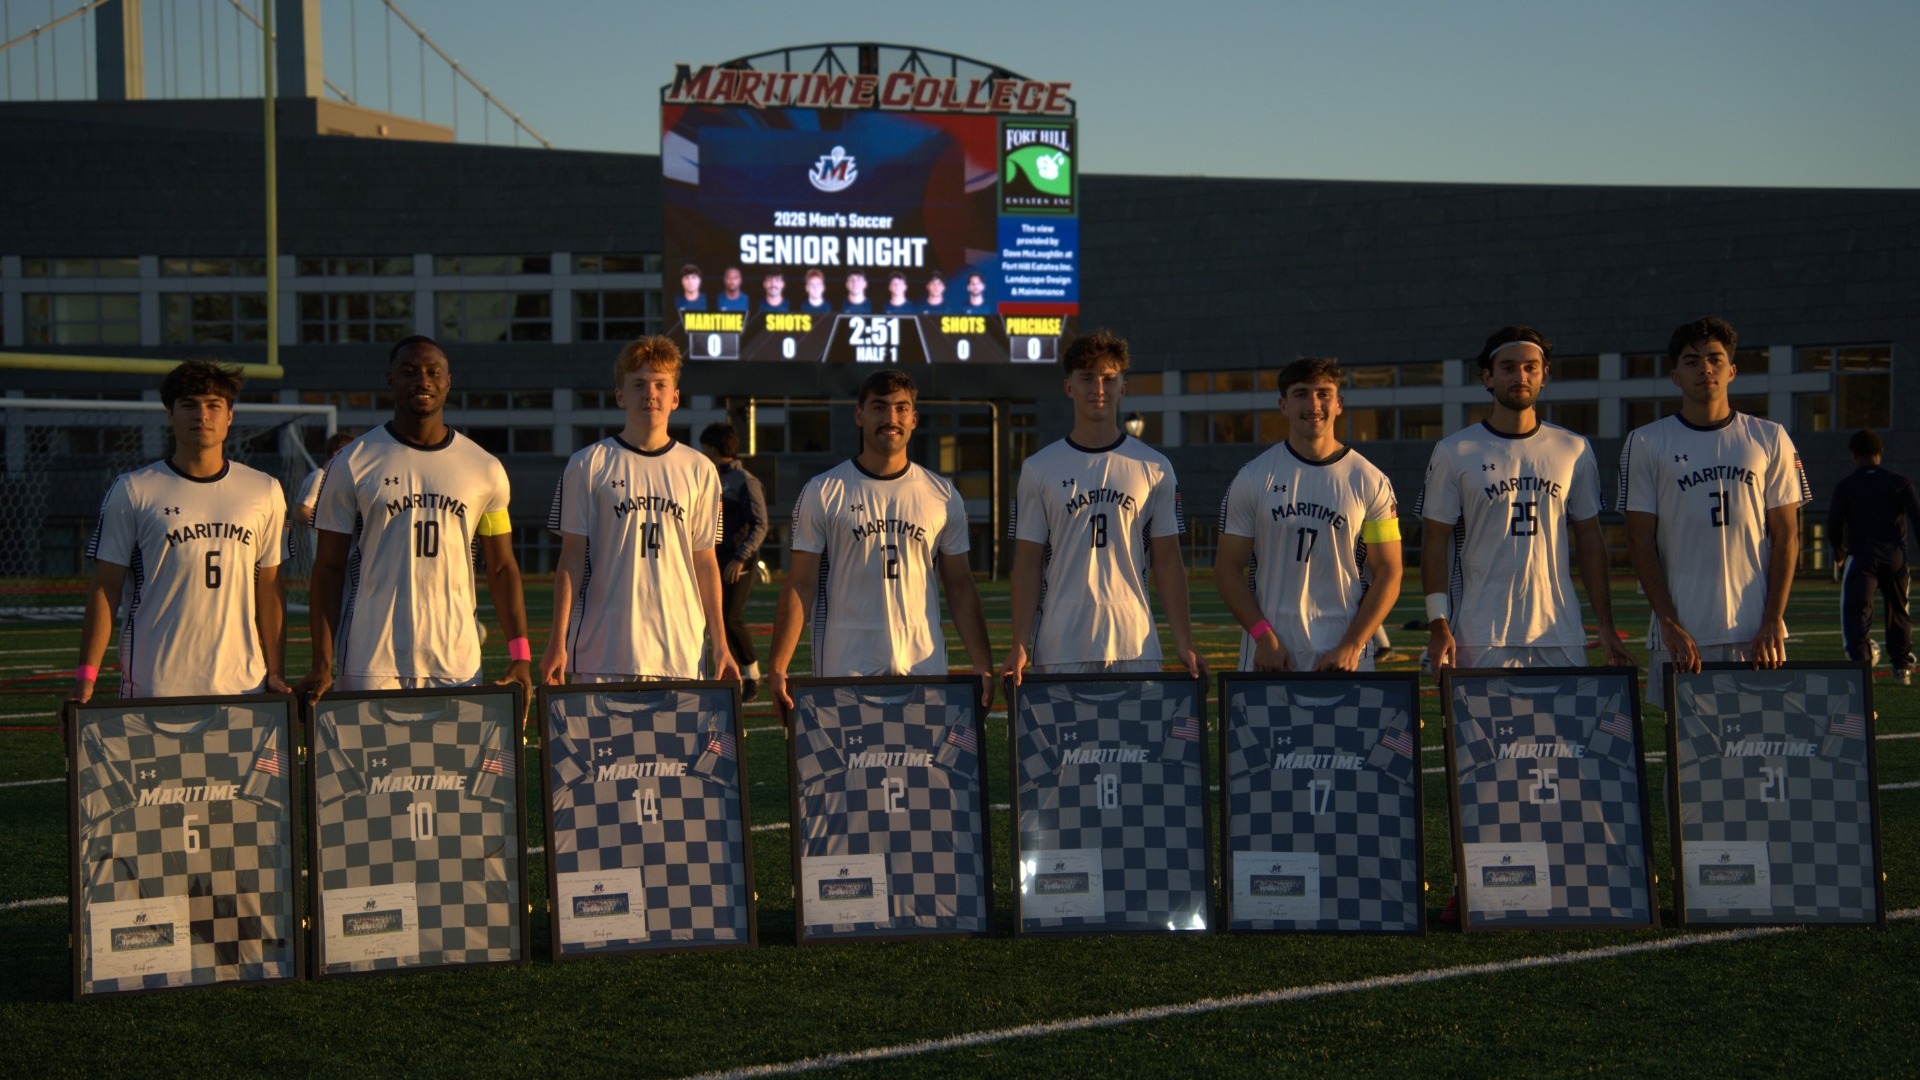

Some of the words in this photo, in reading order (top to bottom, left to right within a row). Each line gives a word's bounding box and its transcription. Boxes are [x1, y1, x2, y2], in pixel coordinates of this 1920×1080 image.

[668, 63, 876, 109] MARITIME
[884, 71, 1071, 114] COLLEGE
[1006, 129, 1037, 150] FORT
[1040, 130, 1070, 151] HILL
[774, 211, 807, 227] 2026
[809, 212, 846, 228] Men's
[848, 213, 893, 229] Soccer
[1021, 224, 1036, 233] The
[1036, 224, 1055, 233] view
[740, 234, 840, 266] SENIOR
[846, 236, 927, 267] NIGHT
[1003, 249, 1021, 258] Dave
[1064, 250, 1073, 259] at
[1016, 237, 1049, 247] provided
[1050, 237, 1060, 247] by
[1002, 262, 1017, 271] Fort
[1018, 262, 1030, 271] Hill
[1031, 262, 1059, 271] Estates
[1004, 275, 1045, 285] Landscape
[1045, 275, 1072, 286] Design
[1018, 287, 1065, 296] Maintenance
[684, 313, 743, 332] MARITIME
[766, 314, 812, 332] SHOTS
[849, 316, 900, 346] 2:51
[941, 316, 986, 334] SHOTS
[1006, 317, 1062, 335] PURCHASE
[707, 333, 722, 357] 0
[782, 337, 796, 359] 0
[856, 346, 886, 362] HALF
[889, 347, 898, 362] 1
[957, 339, 970, 360] 0
[1027, 338, 1041, 360] 0
[1484, 477, 1562, 501] MARITIME
[1677, 465, 1757, 492] MARITIME
[385, 493, 468, 519] MARITIME
[613, 496, 685, 522] MARITIME
[1065, 488, 1135, 514] MARITIME
[1708, 490, 1729, 528] 21
[1271, 502, 1346, 531] MARITIME
[1511, 501, 1538, 537] 25
[165, 522, 254, 548] MARITIME
[414, 520, 439, 558] 10
[639, 522, 661, 559] 14
[851, 519, 927, 544] MARITIME
[1089, 513, 1107, 549] 18
[1296, 527, 1318, 563] 17
[205, 551, 221, 589] 6
[880, 545, 899, 580] 12
[849, 752, 934, 770] MARITIME
[1062, 748, 1150, 765] MARITIME
[1273, 752, 1366, 770] MARITIME
[1499, 742, 1585, 760] MARITIME
[1724, 740, 1818, 758] MARITIME
[597, 762, 688, 782] MARITIME
[137, 784, 240, 807] MARITIME
[369, 775, 467, 795] MARITIME
[880, 777, 905, 814] 12
[1094, 773, 1118, 810] 18
[1528, 768, 1559, 805] 25
[1759, 766, 1785, 803] 21
[632, 787, 658, 825] 14
[1307, 779, 1331, 816] 17
[183, 814, 200, 853] 6
[407, 801, 433, 842] 10
